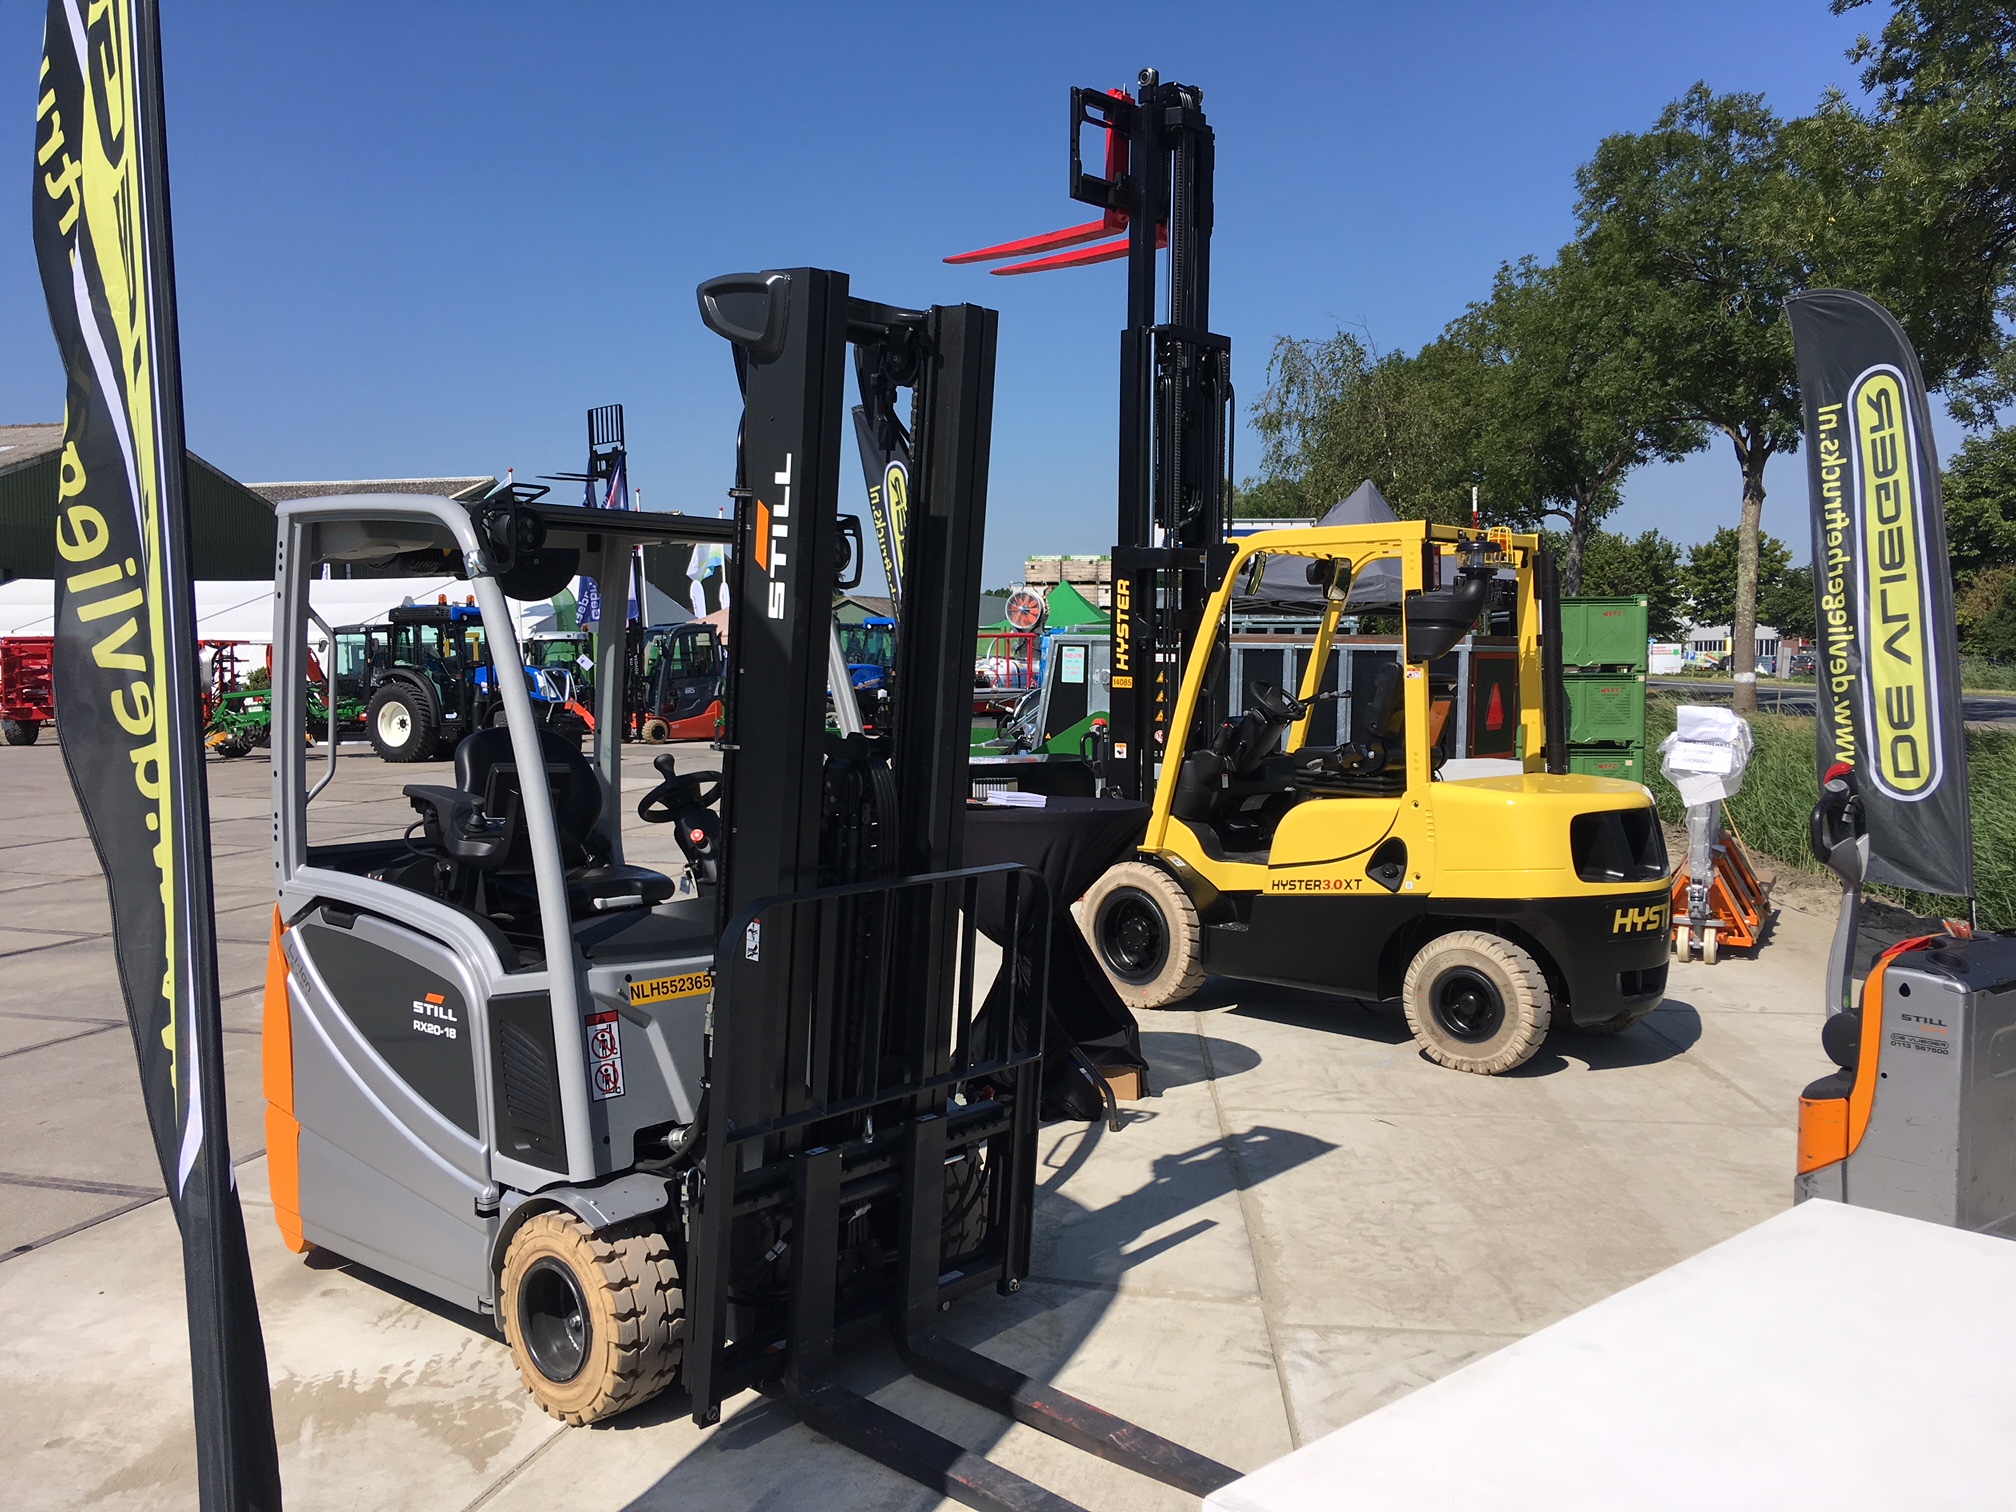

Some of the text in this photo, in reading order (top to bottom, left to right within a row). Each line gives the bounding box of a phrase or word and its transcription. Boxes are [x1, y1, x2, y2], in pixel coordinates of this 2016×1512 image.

[768, 453, 792, 619] STILL
[1116, 579, 1130, 670] HYSTER
[1612, 903, 1671, 933] HYST
[630, 975, 711, 1001] NLH552365
[413, 1001, 457, 1021] STILL
[1901, 1013, 1947, 1027] STILL
[413, 1020, 457, 1039] RX20-18
[1890, 1041, 1911, 1049] 0113
